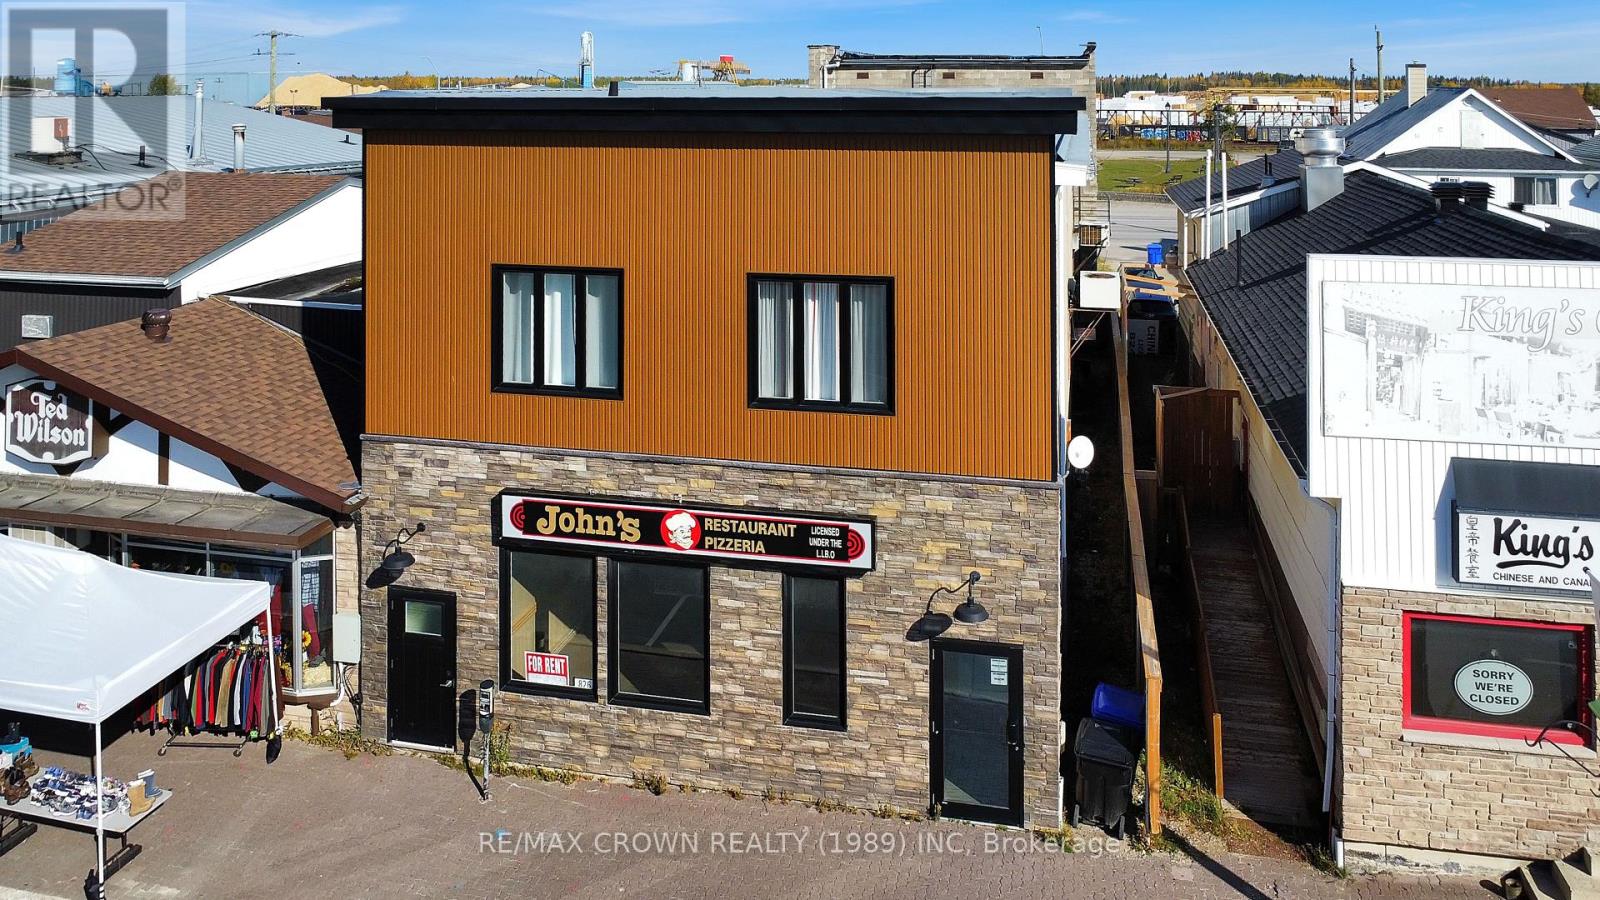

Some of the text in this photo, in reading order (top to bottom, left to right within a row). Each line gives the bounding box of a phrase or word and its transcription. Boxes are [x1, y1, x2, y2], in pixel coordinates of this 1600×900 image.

[1456, 295, 1586, 353] King's
[30, 391, 69, 420] Ted
[14, 411, 86, 447] Wilson
[536, 505, 642, 542] John's
[704, 517, 797, 537] RESTAURANT
[811, 526, 840, 537] LICENSED
[704, 536, 766, 554] PIZZERIA
[808, 537, 843, 549] UNDER THE
[1493, 517, 1594, 569] King's
[1493, 572, 1592, 587] CHINESE AND CANA
[527, 655, 566, 675] FOR RENT
[1472, 669, 1515, 681] SORRY
[1474, 681, 1514, 693] WE'RE
[1469, 693, 1519, 706] CLOSED
